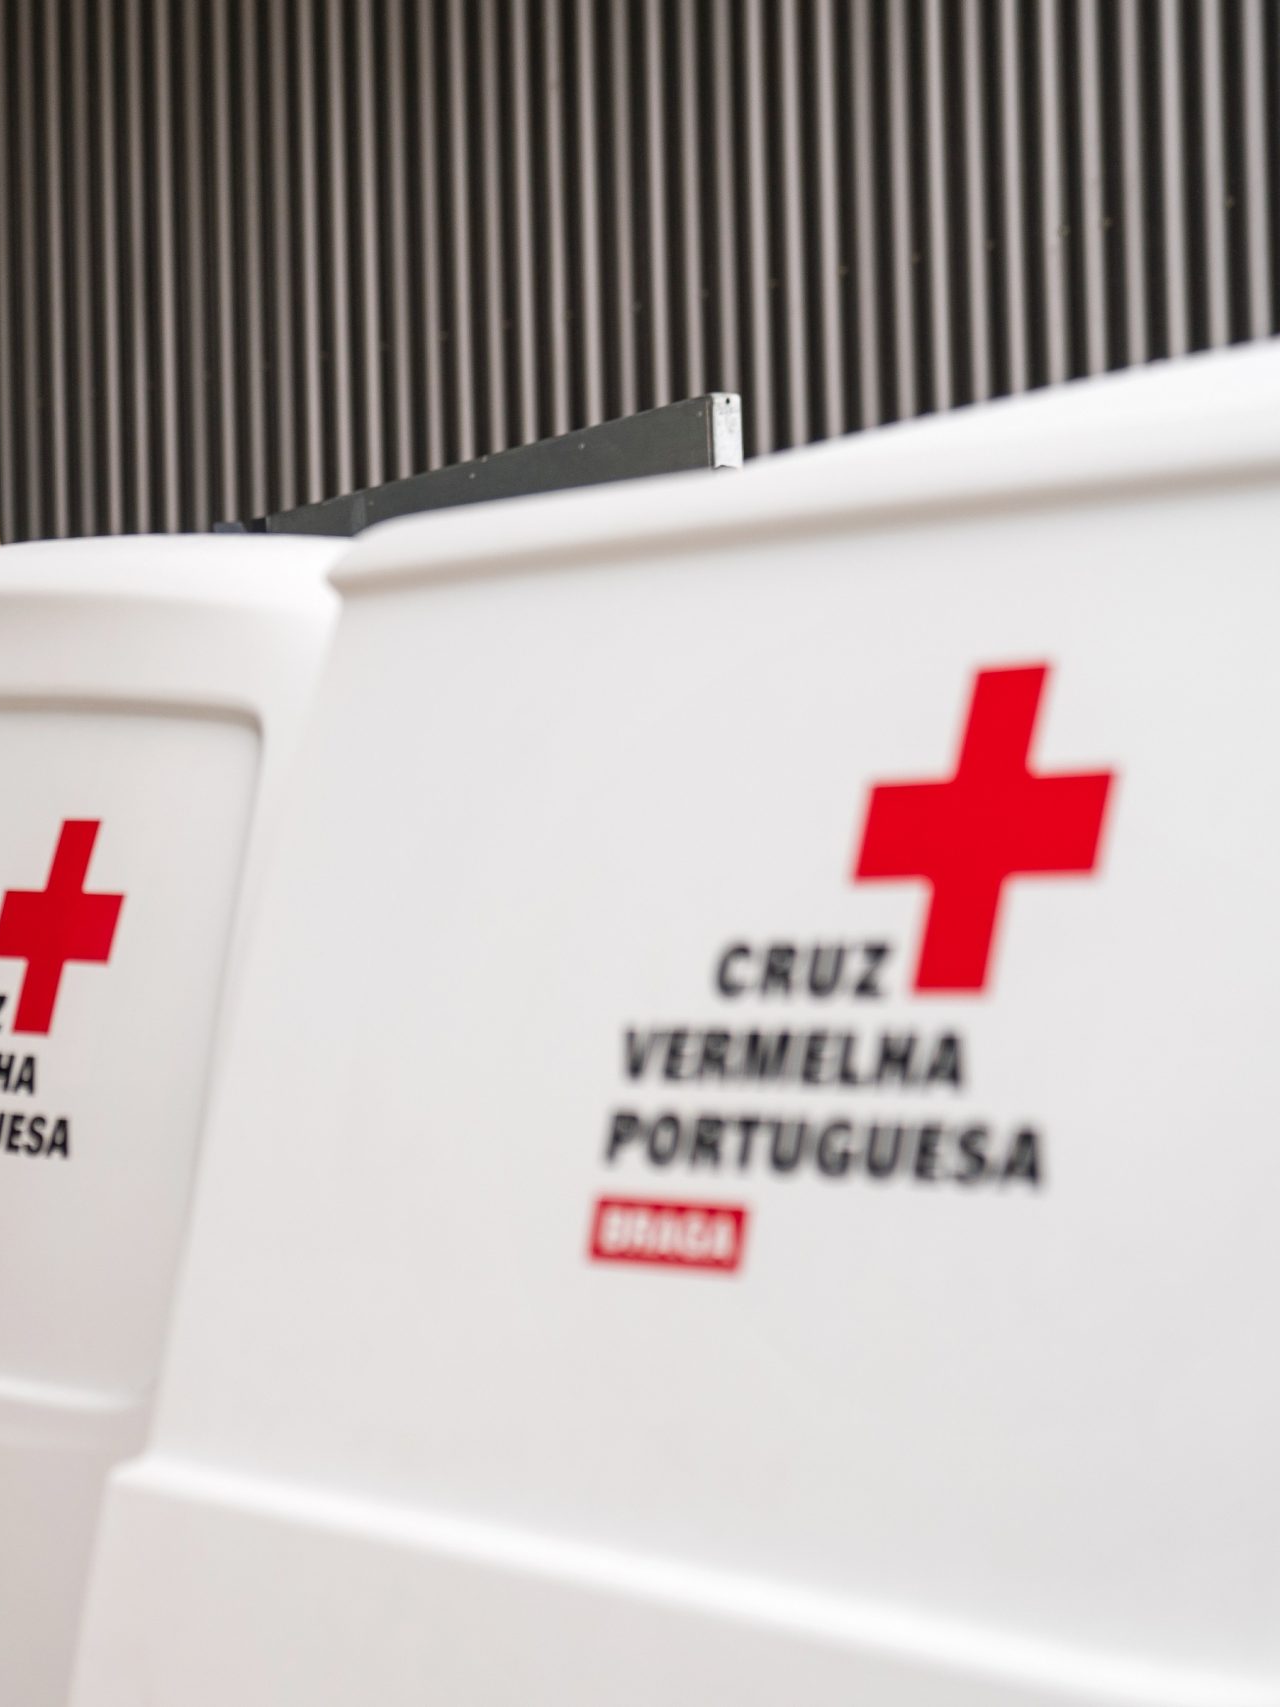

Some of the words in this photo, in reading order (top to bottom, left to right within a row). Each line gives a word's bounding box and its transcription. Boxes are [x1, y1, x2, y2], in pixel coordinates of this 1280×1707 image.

[716, 941, 891, 1000] CRUZ
[625, 1027, 965, 1090] VERMELHA
[605, 1110, 1043, 1188] PORTUGUESA
[600, 1209, 734, 1259] BRAGA
